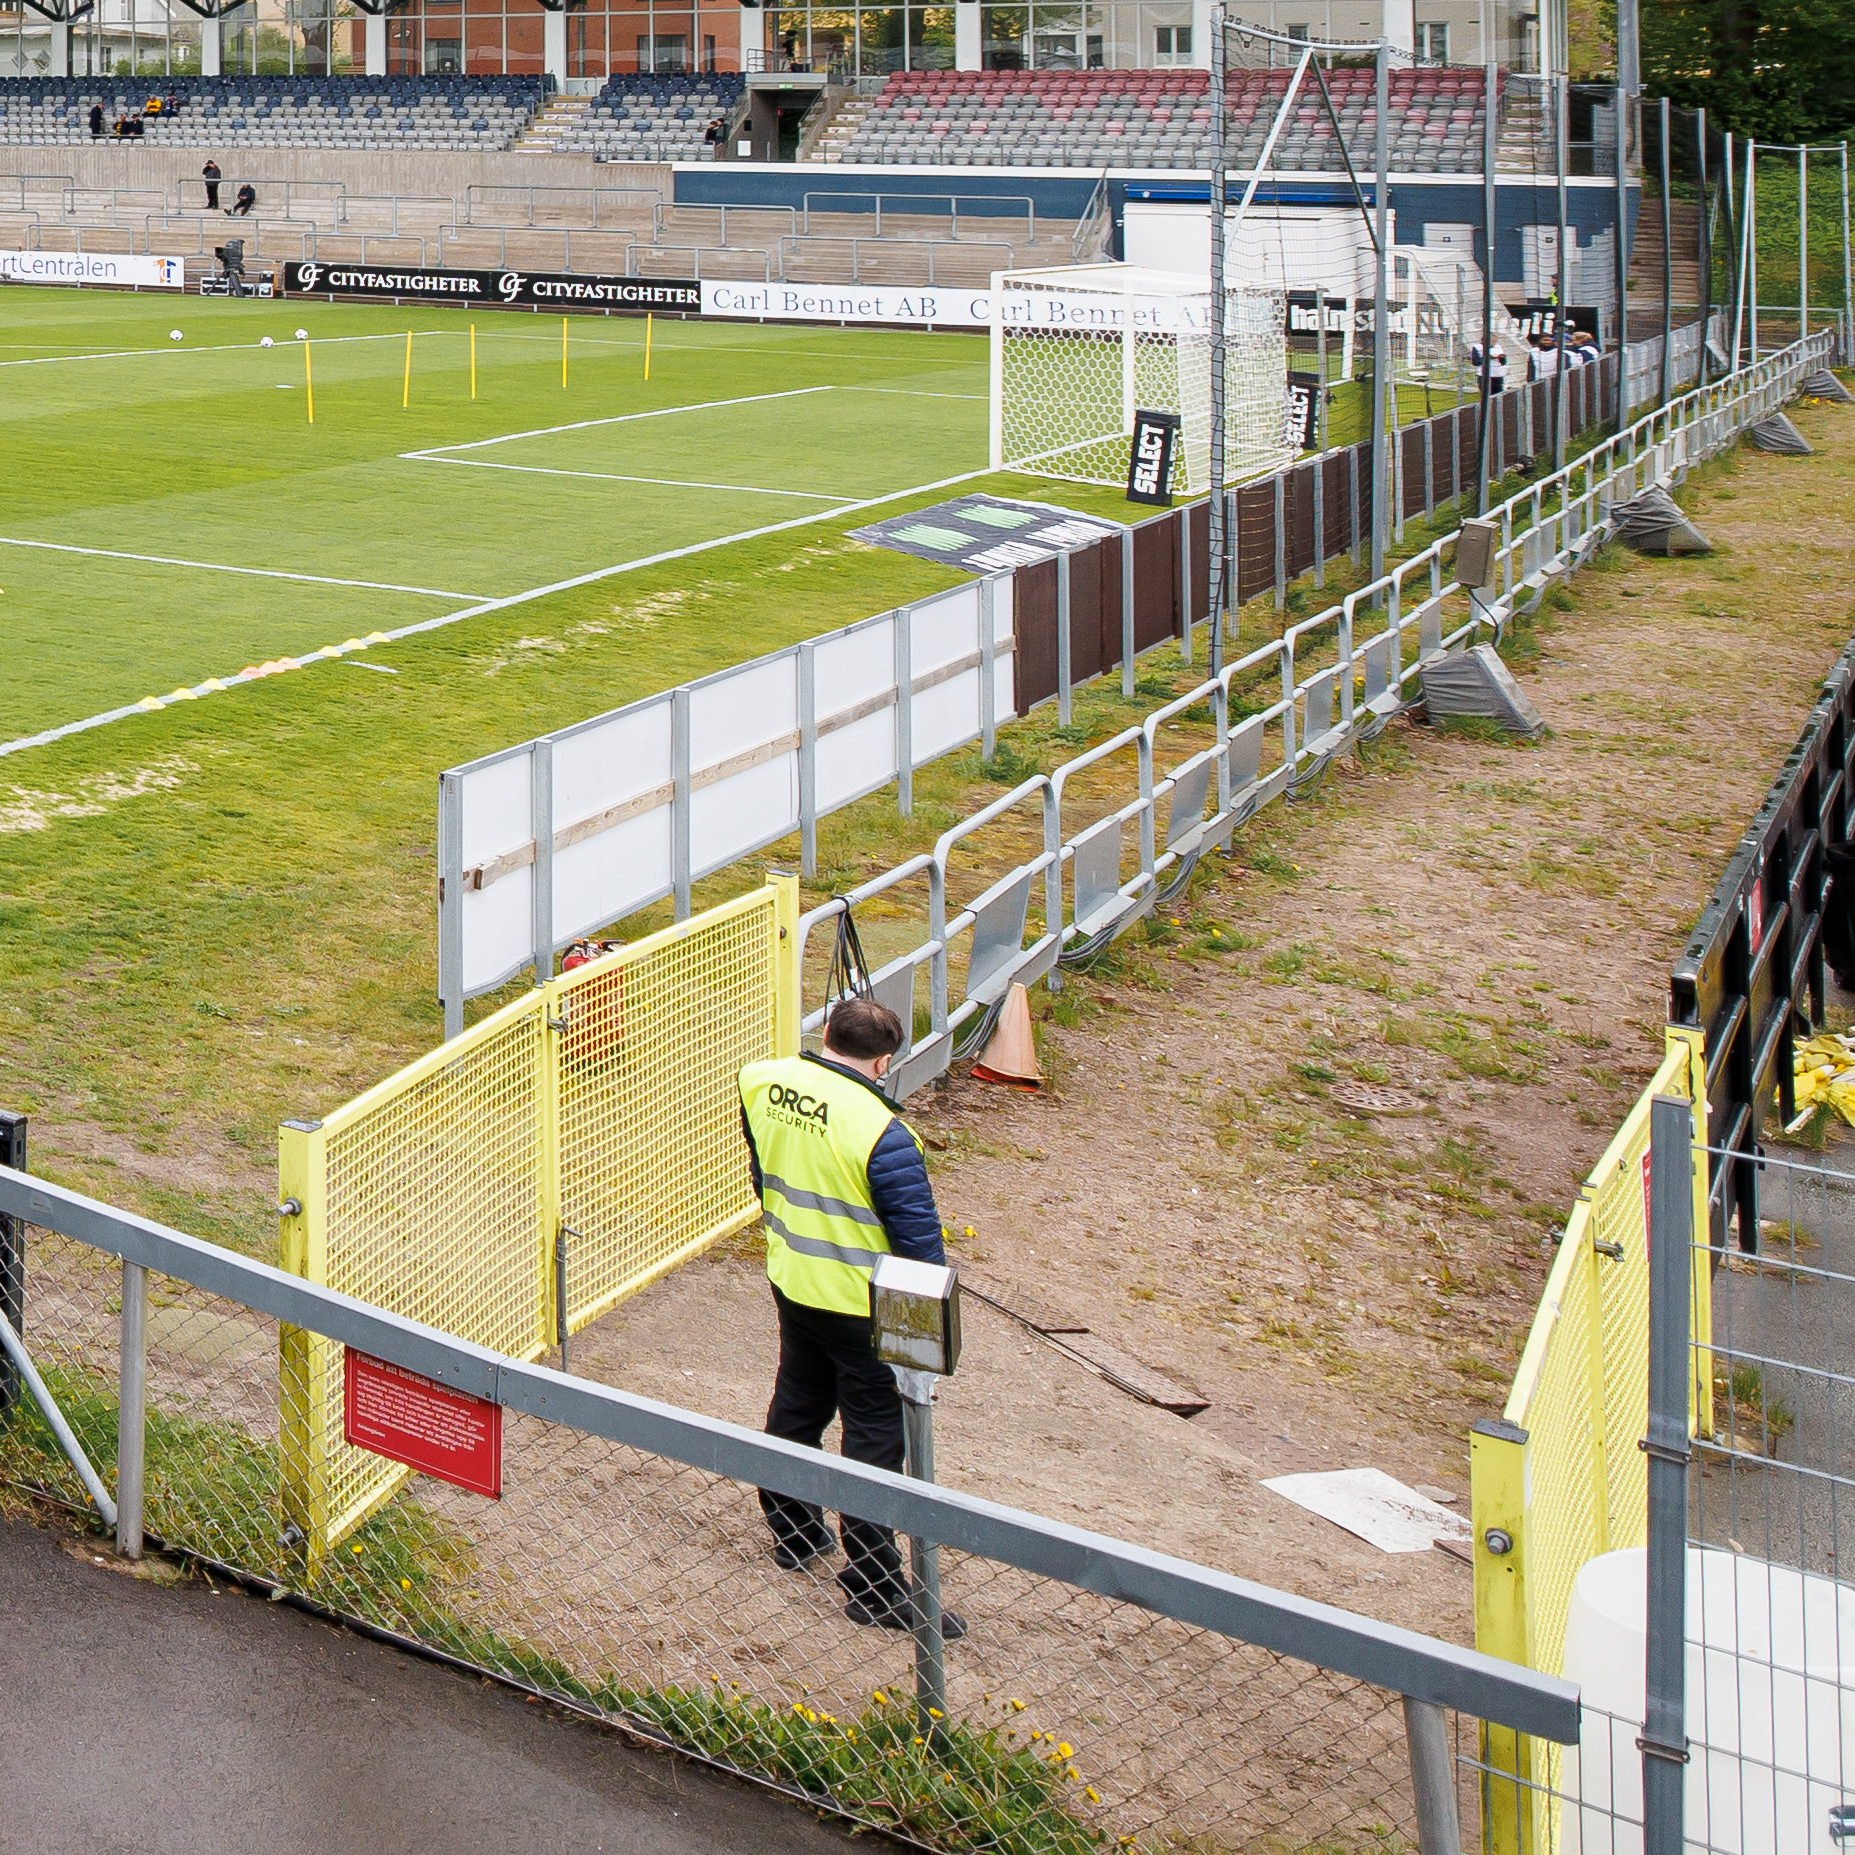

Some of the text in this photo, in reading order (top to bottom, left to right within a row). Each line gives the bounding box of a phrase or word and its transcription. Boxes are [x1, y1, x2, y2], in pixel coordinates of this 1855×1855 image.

[328, 272, 482, 293] CITYFASTIGHETER
[533, 282, 701, 304] CITYFASTIGHETER
[713, 288, 938, 319] Carl Bennet AB
[1134, 424, 1165, 495] SELECT
[768, 1083, 828, 1126] ORCA
[766, 1108, 827, 1138] SECURITY
